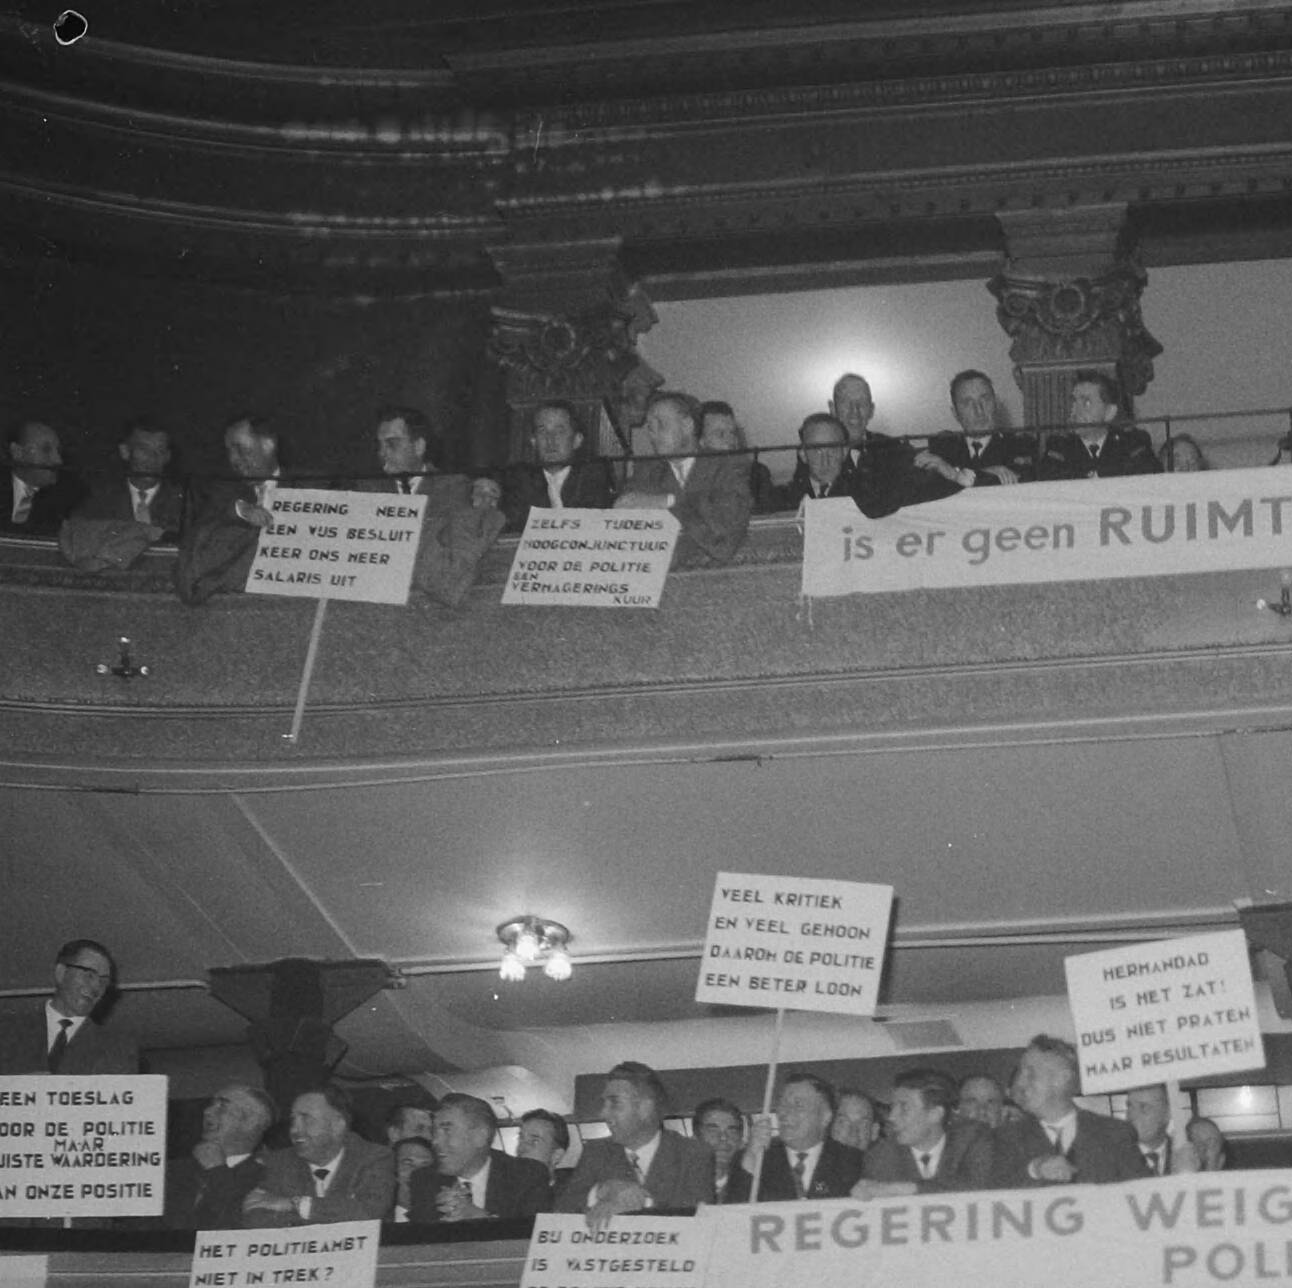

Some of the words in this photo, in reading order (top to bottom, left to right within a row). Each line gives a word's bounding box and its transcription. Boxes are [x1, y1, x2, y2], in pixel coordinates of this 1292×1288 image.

[272, 501, 349, 515] REGERING
[266, 524, 297, 535] EEN
[346, 528, 414, 542] BESLUIT
[530, 519, 581, 530] ZELFS
[841, 526, 875, 561] is
[896, 530, 946, 558] er
[961, 523, 1075, 565] geen
[260, 546, 301, 559] KEER
[308, 549, 339, 562] ONS
[348, 553, 390, 564] MEER
[518, 560, 558, 571] VOOR
[563, 561, 582, 572] DE
[590, 561, 651, 573] POLITIE
[253, 569, 322, 584] SALARIS
[330, 574, 357, 587] UIT
[511, 582, 629, 594] VERMAGERINGS
[721, 888, 764, 903] VEEL
[774, 891, 843, 909] KRITIEK
[715, 917, 738, 930] EN
[745, 918, 789, 934] VEEL
[801, 922, 870, 939] GEHOON
[710, 944, 777, 961] DAAROM
[784, 950, 804, 964] DE
[809, 952, 875, 970] POLITIE
[1103, 952, 1210, 981] HERMANDAD
[705, 973, 740, 987] EEN
[749, 976, 807, 993] BETER
[815, 981, 863, 997] LOON
[1110, 995, 1126, 1010] IS
[1137, 987, 1171, 1006] HET
[1081, 1029, 1116, 1047] DUS
[1127, 1019, 1167, 1039] NIET
[1177, 1007, 1250, 1030] PRATEN
[1086, 1056, 1133, 1076] MAAR
[1141, 1038, 1254, 1066] RESULTATEN
[47, 1090, 134, 1106] TOESLAG
[45, 1122, 69, 1137] DE
[82, 1121, 156, 1136] POLITIE
[54, 1137, 104, 1152] MAAR
[51, 1152, 161, 1168] WAARDERING
[25, 1184, 74, 1200] ONZE
[81, 1183, 153, 1198] POSITIE
[750, 1196, 1085, 1254] REGERING
[571, 1231, 680, 1244] ONDERZOEK
[200, 1244, 237, 1258] HET
[248, 1236, 367, 1257] POLITIEAMBT
[531, 1258, 548, 1271] IS
[566, 1258, 695, 1272] VASTGESTELD
[195, 1272, 238, 1286] NIET
[246, 1271, 264, 1284] IN
